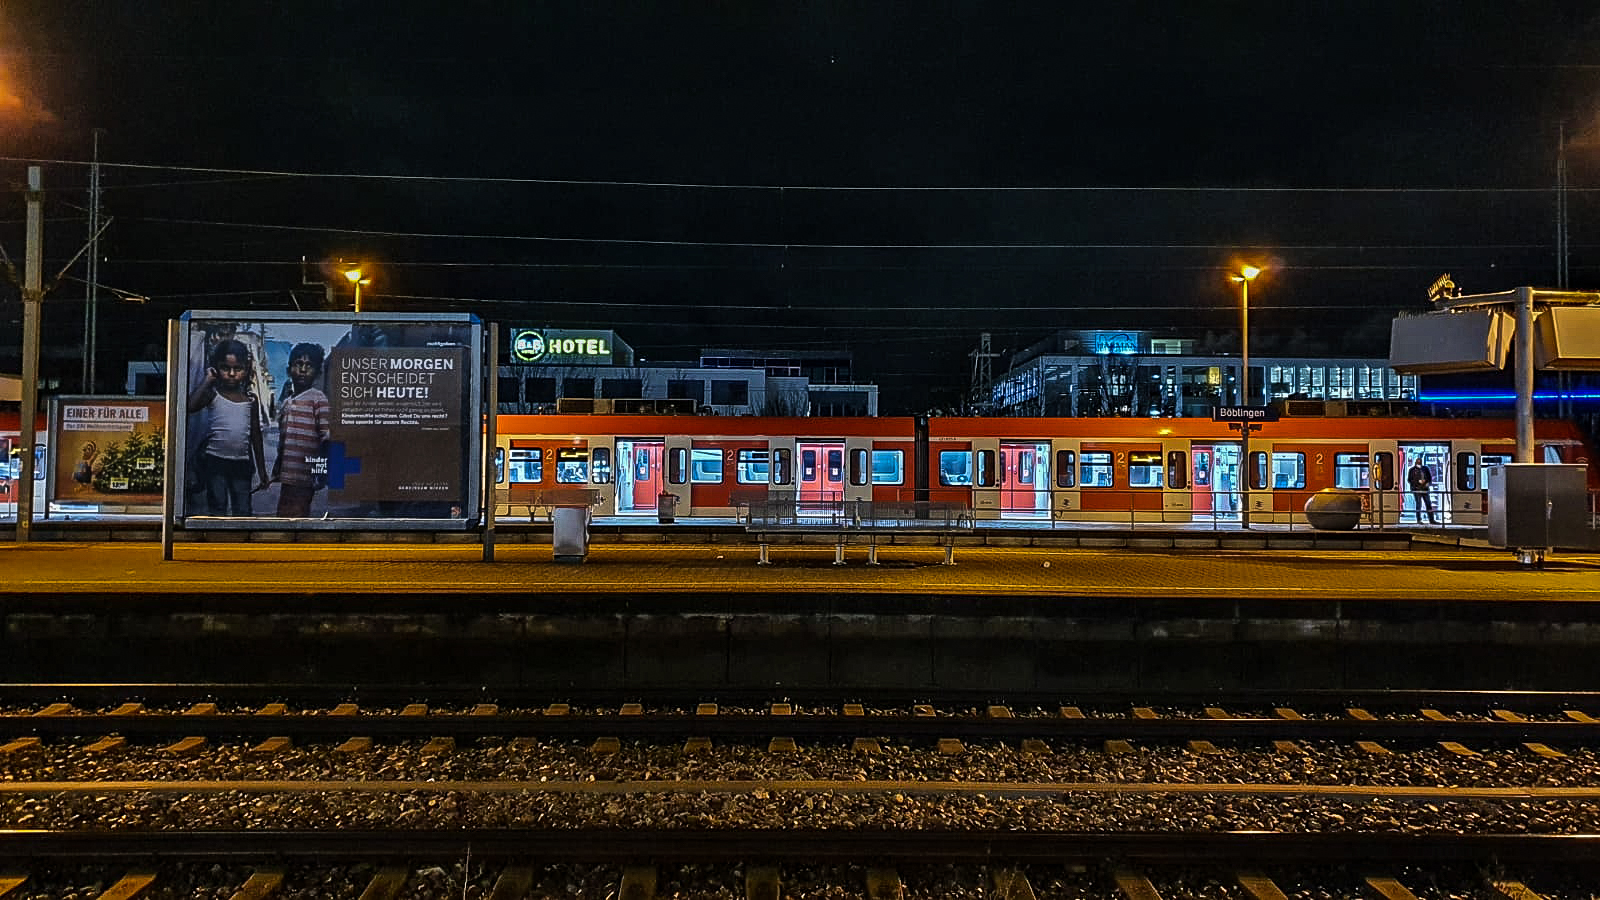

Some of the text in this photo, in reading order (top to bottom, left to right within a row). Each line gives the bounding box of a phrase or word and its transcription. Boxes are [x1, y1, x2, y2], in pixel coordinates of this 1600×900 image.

[548, 339, 610, 354] HOTEL
[341, 358, 454, 370] UNSER MORGEN
[341, 372, 436, 384] ENTSCHEIDET
[341, 386, 429, 399] SICH HEUTE!
[66, 407, 96, 419] EINER
[98, 407, 117, 419] FÜR
[1220, 407, 1265, 419] Böblingen
[546, 449, 553, 460] 2
[727, 450, 734, 461] 2
[1117, 452, 1125, 464] 2
[1316, 453, 1323, 465] 2
